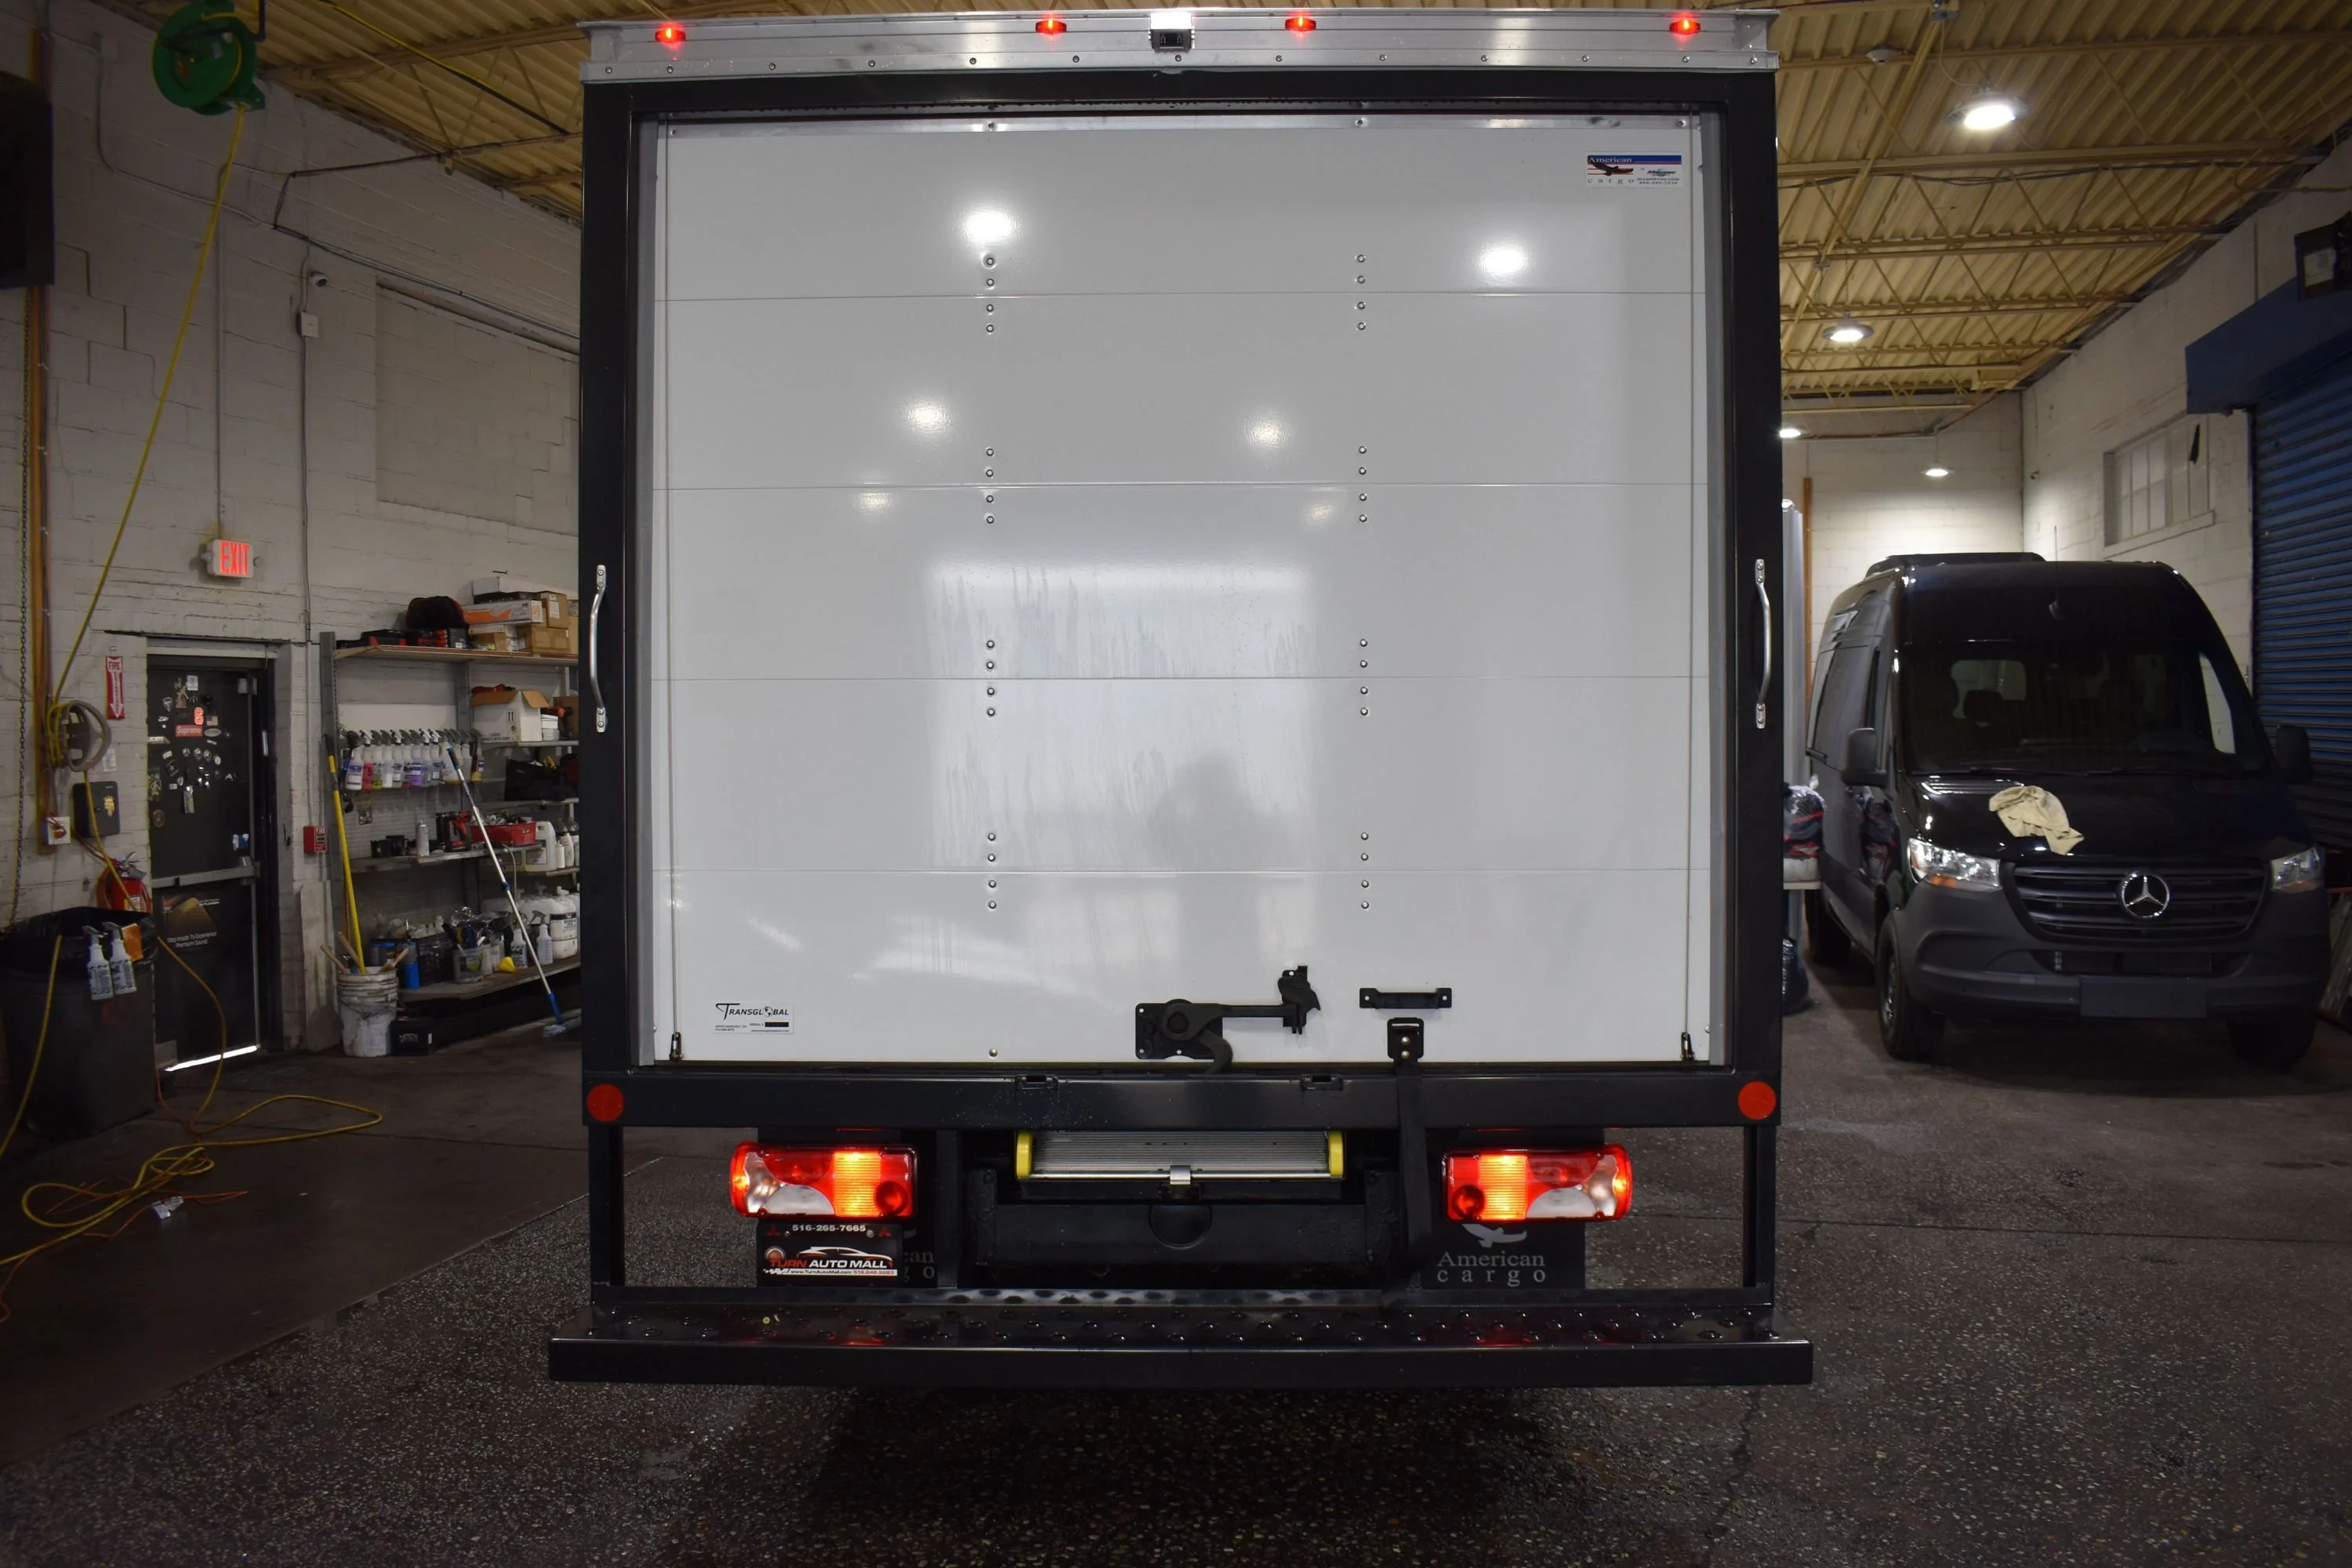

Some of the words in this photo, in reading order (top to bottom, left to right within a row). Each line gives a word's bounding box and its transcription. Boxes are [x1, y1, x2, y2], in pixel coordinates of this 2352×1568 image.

[221, 541, 249, 575] EXIT
[176, 727, 201, 735] Supreme
[809, 1260, 847, 1269] AUTO
[849, 1260, 887, 1269] MALL
[1437, 1250, 1546, 1267] American
[1437, 1269, 1546, 1287] cargo
